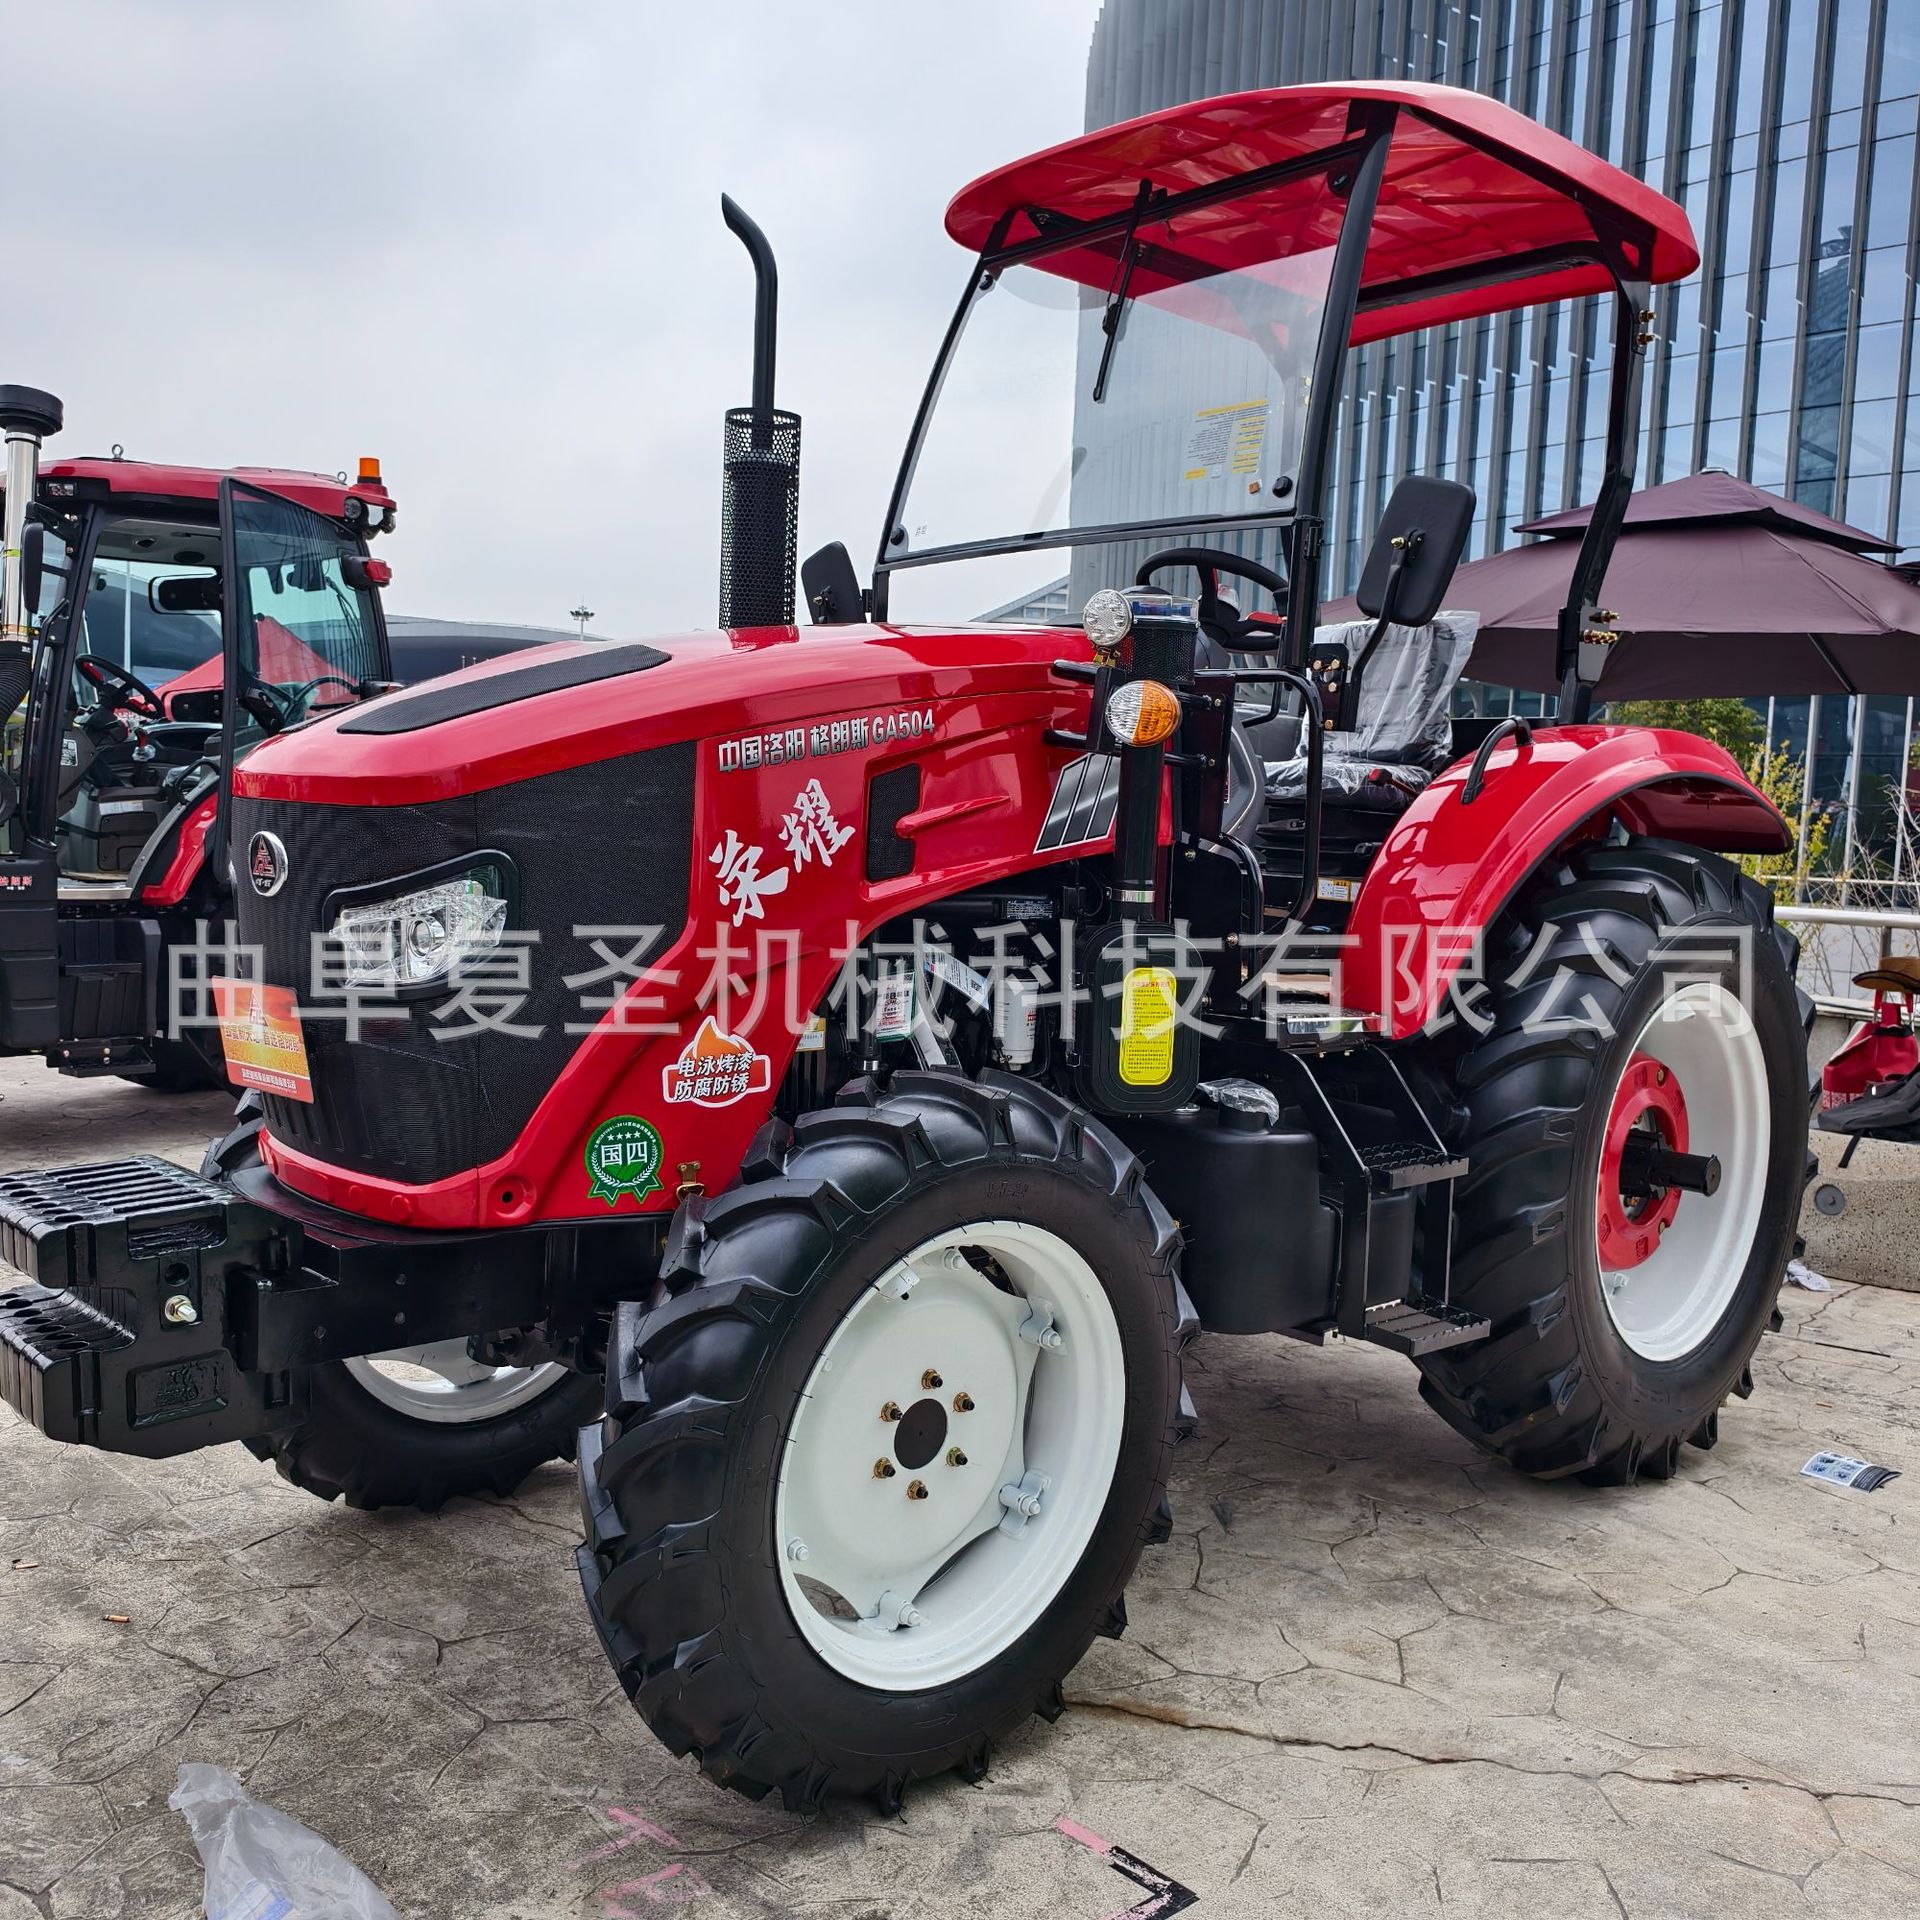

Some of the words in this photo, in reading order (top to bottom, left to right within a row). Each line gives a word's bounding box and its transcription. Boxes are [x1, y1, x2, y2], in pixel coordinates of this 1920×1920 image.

[718, 728, 806, 772] 中国洛阳
[809, 716, 869, 757] 格朗斯
[872, 708, 935, 744] GA504
[709, 778, 856, 927] 荣耀
[678, 1051, 754, 1078] 电泳烤漆
[673, 1072, 750, 1101] 防腐防锈
[600, 1140, 648, 1168] 国四
